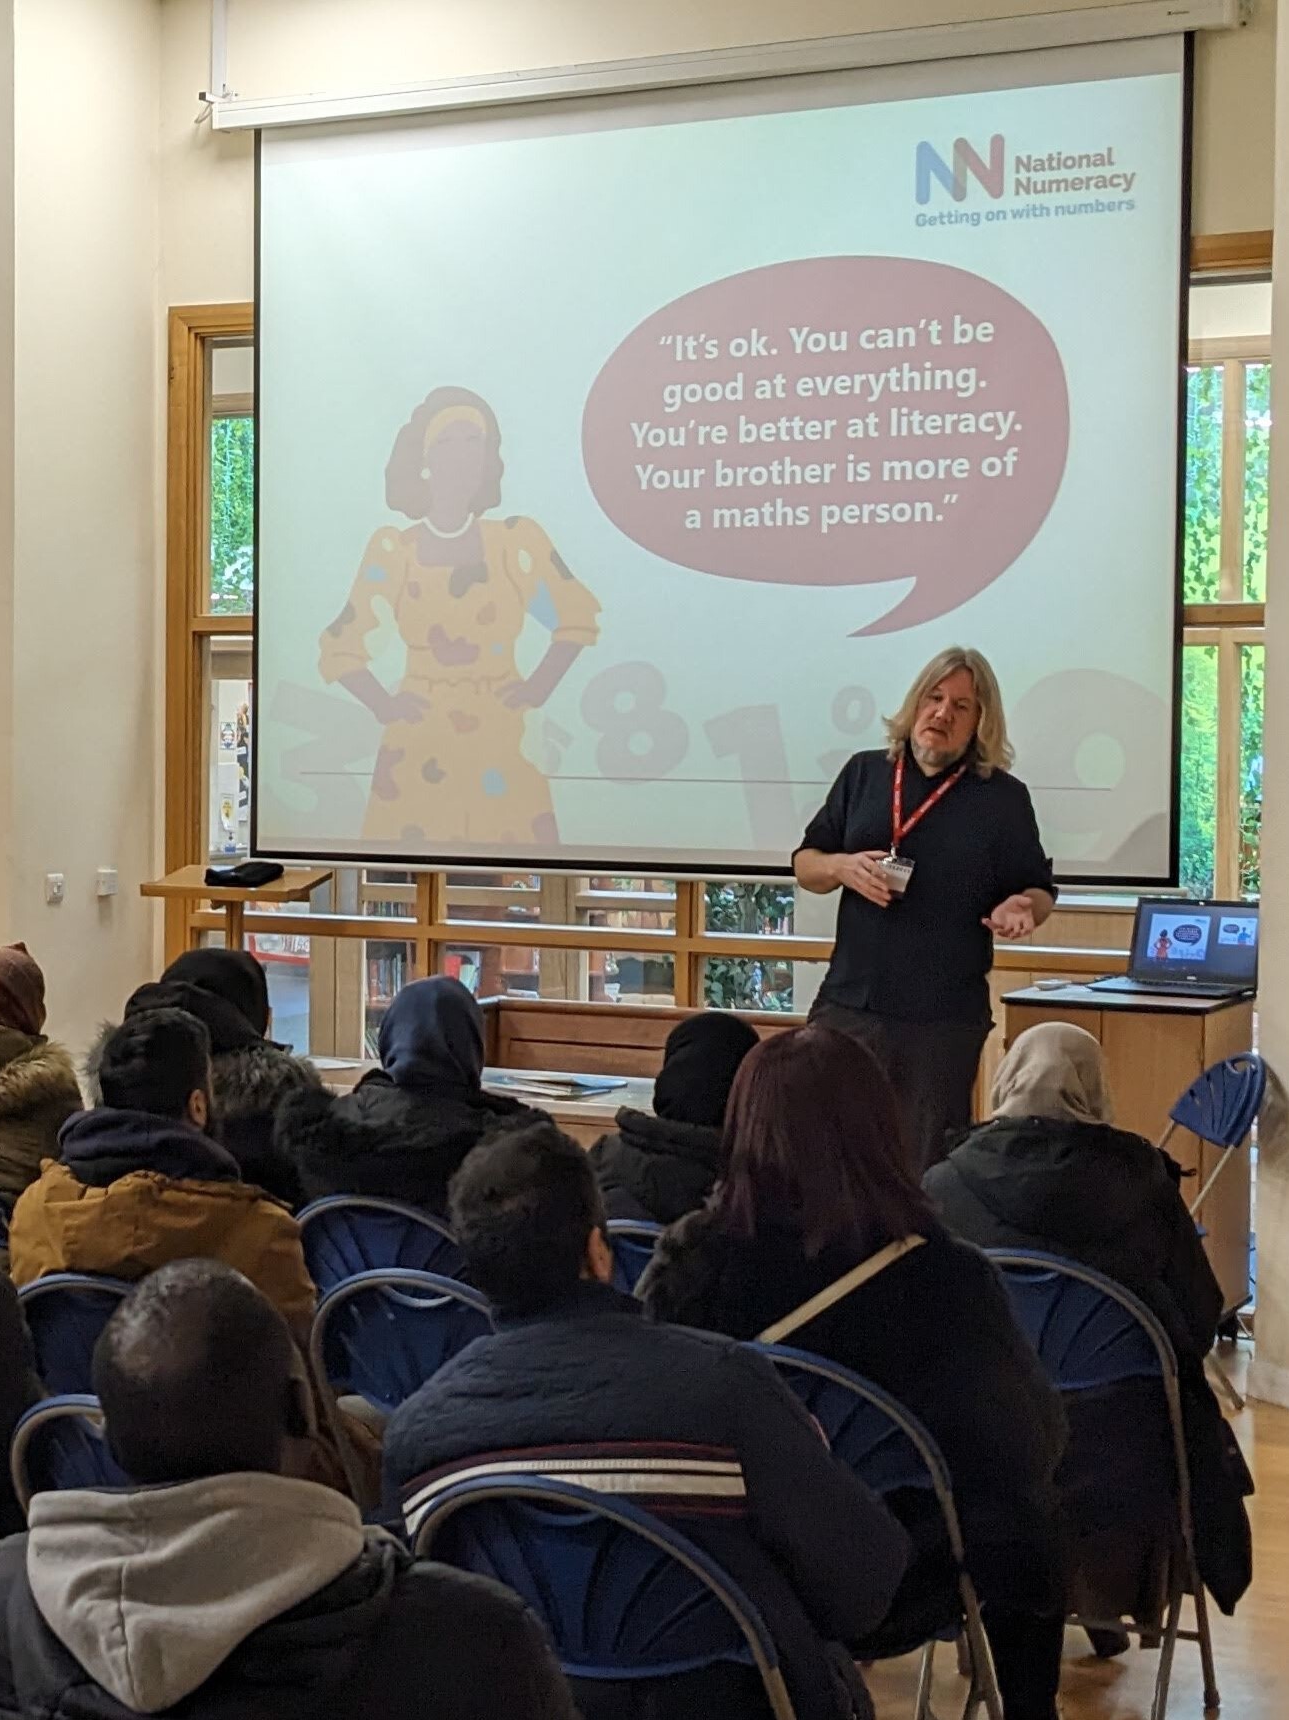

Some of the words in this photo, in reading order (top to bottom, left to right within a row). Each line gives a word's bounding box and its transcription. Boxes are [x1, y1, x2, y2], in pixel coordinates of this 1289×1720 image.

[1014, 147, 1115, 174] National
[1014, 172, 1136, 196] Numeracy
[915, 212, 981, 227] Getting
[985, 207, 1008, 222] on
[1010, 203, 1051, 220] with
[1054, 199, 1135, 216] numbers
[660, 333, 718, 361] “It’s
[729, 328, 778, 358] ok.
[789, 326, 848, 354] You
[859, 319, 942, 349] can’t
[954, 315, 994, 344] be
[663, 372, 743, 412] good
[754, 373, 787, 399] at
[796, 362, 987, 402] everything.
[631, 420, 728, 448] You’re
[739, 415, 837, 444] better
[846, 413, 879, 438] at
[890, 407, 1022, 440] literacy.
[636, 463, 705, 490] Your
[715, 456, 836, 487] brother
[847, 454, 871, 483] is
[882, 457, 970, 481] more
[981, 447, 1019, 477] of
[685, 509, 701, 529] a
[713, 498, 810, 528] maths
[820, 494, 958, 533] person.”
